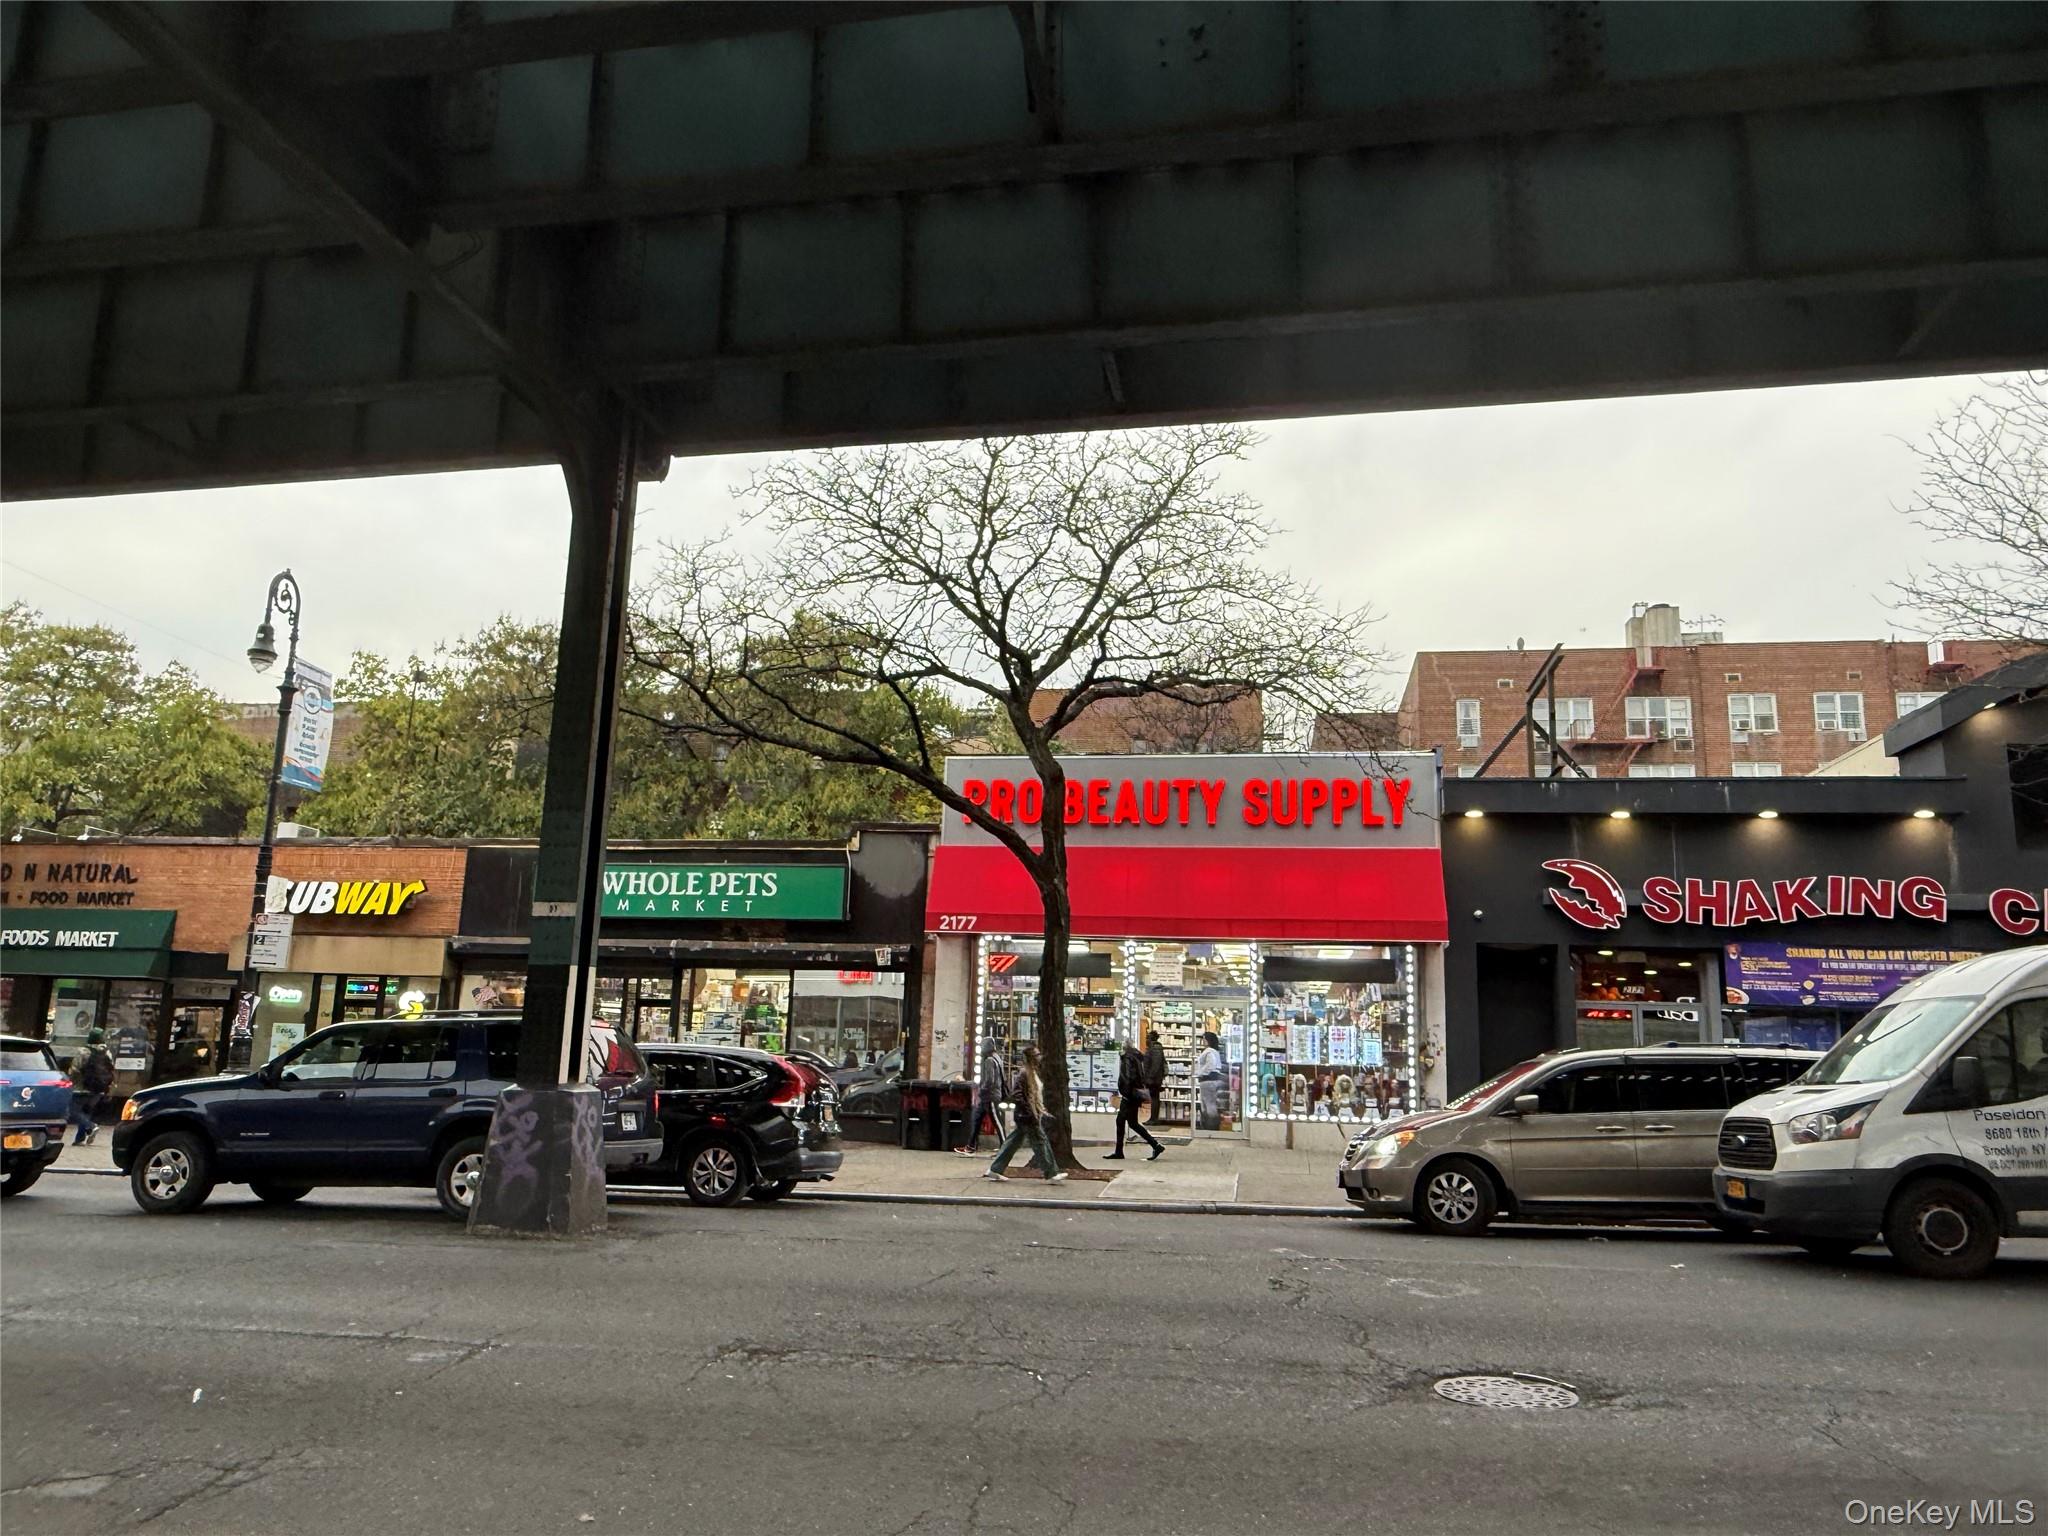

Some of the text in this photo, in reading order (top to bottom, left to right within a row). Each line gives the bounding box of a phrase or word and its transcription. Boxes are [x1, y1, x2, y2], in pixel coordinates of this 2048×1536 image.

[962, 777, 1412, 828] PRO BEAUTY SUPPLY
[24, 862, 38, 882] N
[48, 862, 138, 884] NATURAL
[603, 871, 778, 896] WHOLE PETS
[29, 891, 68, 905] FOOD
[77, 891, 135, 905] MARKET
[287, 880, 427, 915] UBWAY
[617, 899, 753, 912] MARKET
[1641, 876, 2048, 935] SHAKING C
[940, 916, 977, 930] 2177
[0, 930, 119, 947] FOODS MARKET
[1828, 949, 1845, 959] ALL
[1847, 949, 1865, 960] YOU
[1867, 950, 1886, 960] CAN
[1888, 950, 1905, 960] EAT
[1907, 950, 1947, 961] LOBSTER
[1973, 1109, 2046, 1121] Poseidon
[1983, 1144, 2028, 1158] Brooklyn
